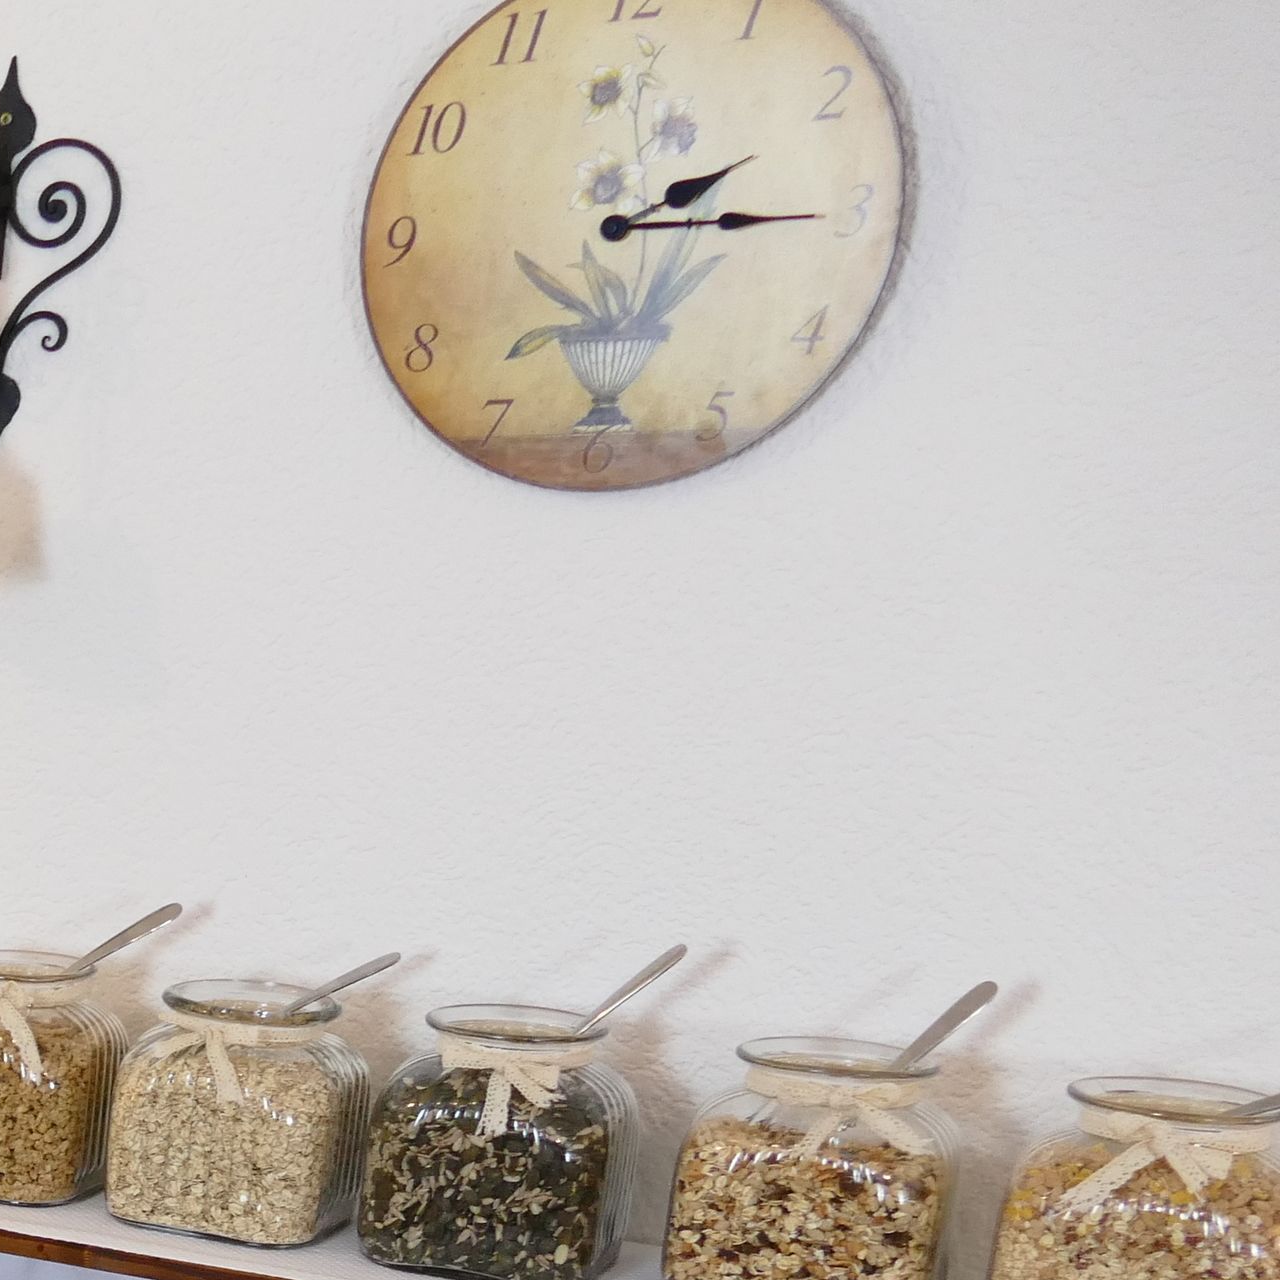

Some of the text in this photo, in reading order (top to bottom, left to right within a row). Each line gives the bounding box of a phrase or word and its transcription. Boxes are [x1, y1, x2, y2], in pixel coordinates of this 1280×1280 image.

[489, 9, 549, 66] 11
[735, 0, 760, 41] 1
[812, 65, 852, 122] 2
[406, 100, 468, 157] 10
[834, 183, 875, 239] 3
[382, 215, 417, 269] 9
[403, 322, 439, 374] 8
[790, 304, 831, 356] 4
[480, 399, 514, 449] 7
[695, 390, 735, 442] 5
[581, 423, 614, 474] 6
